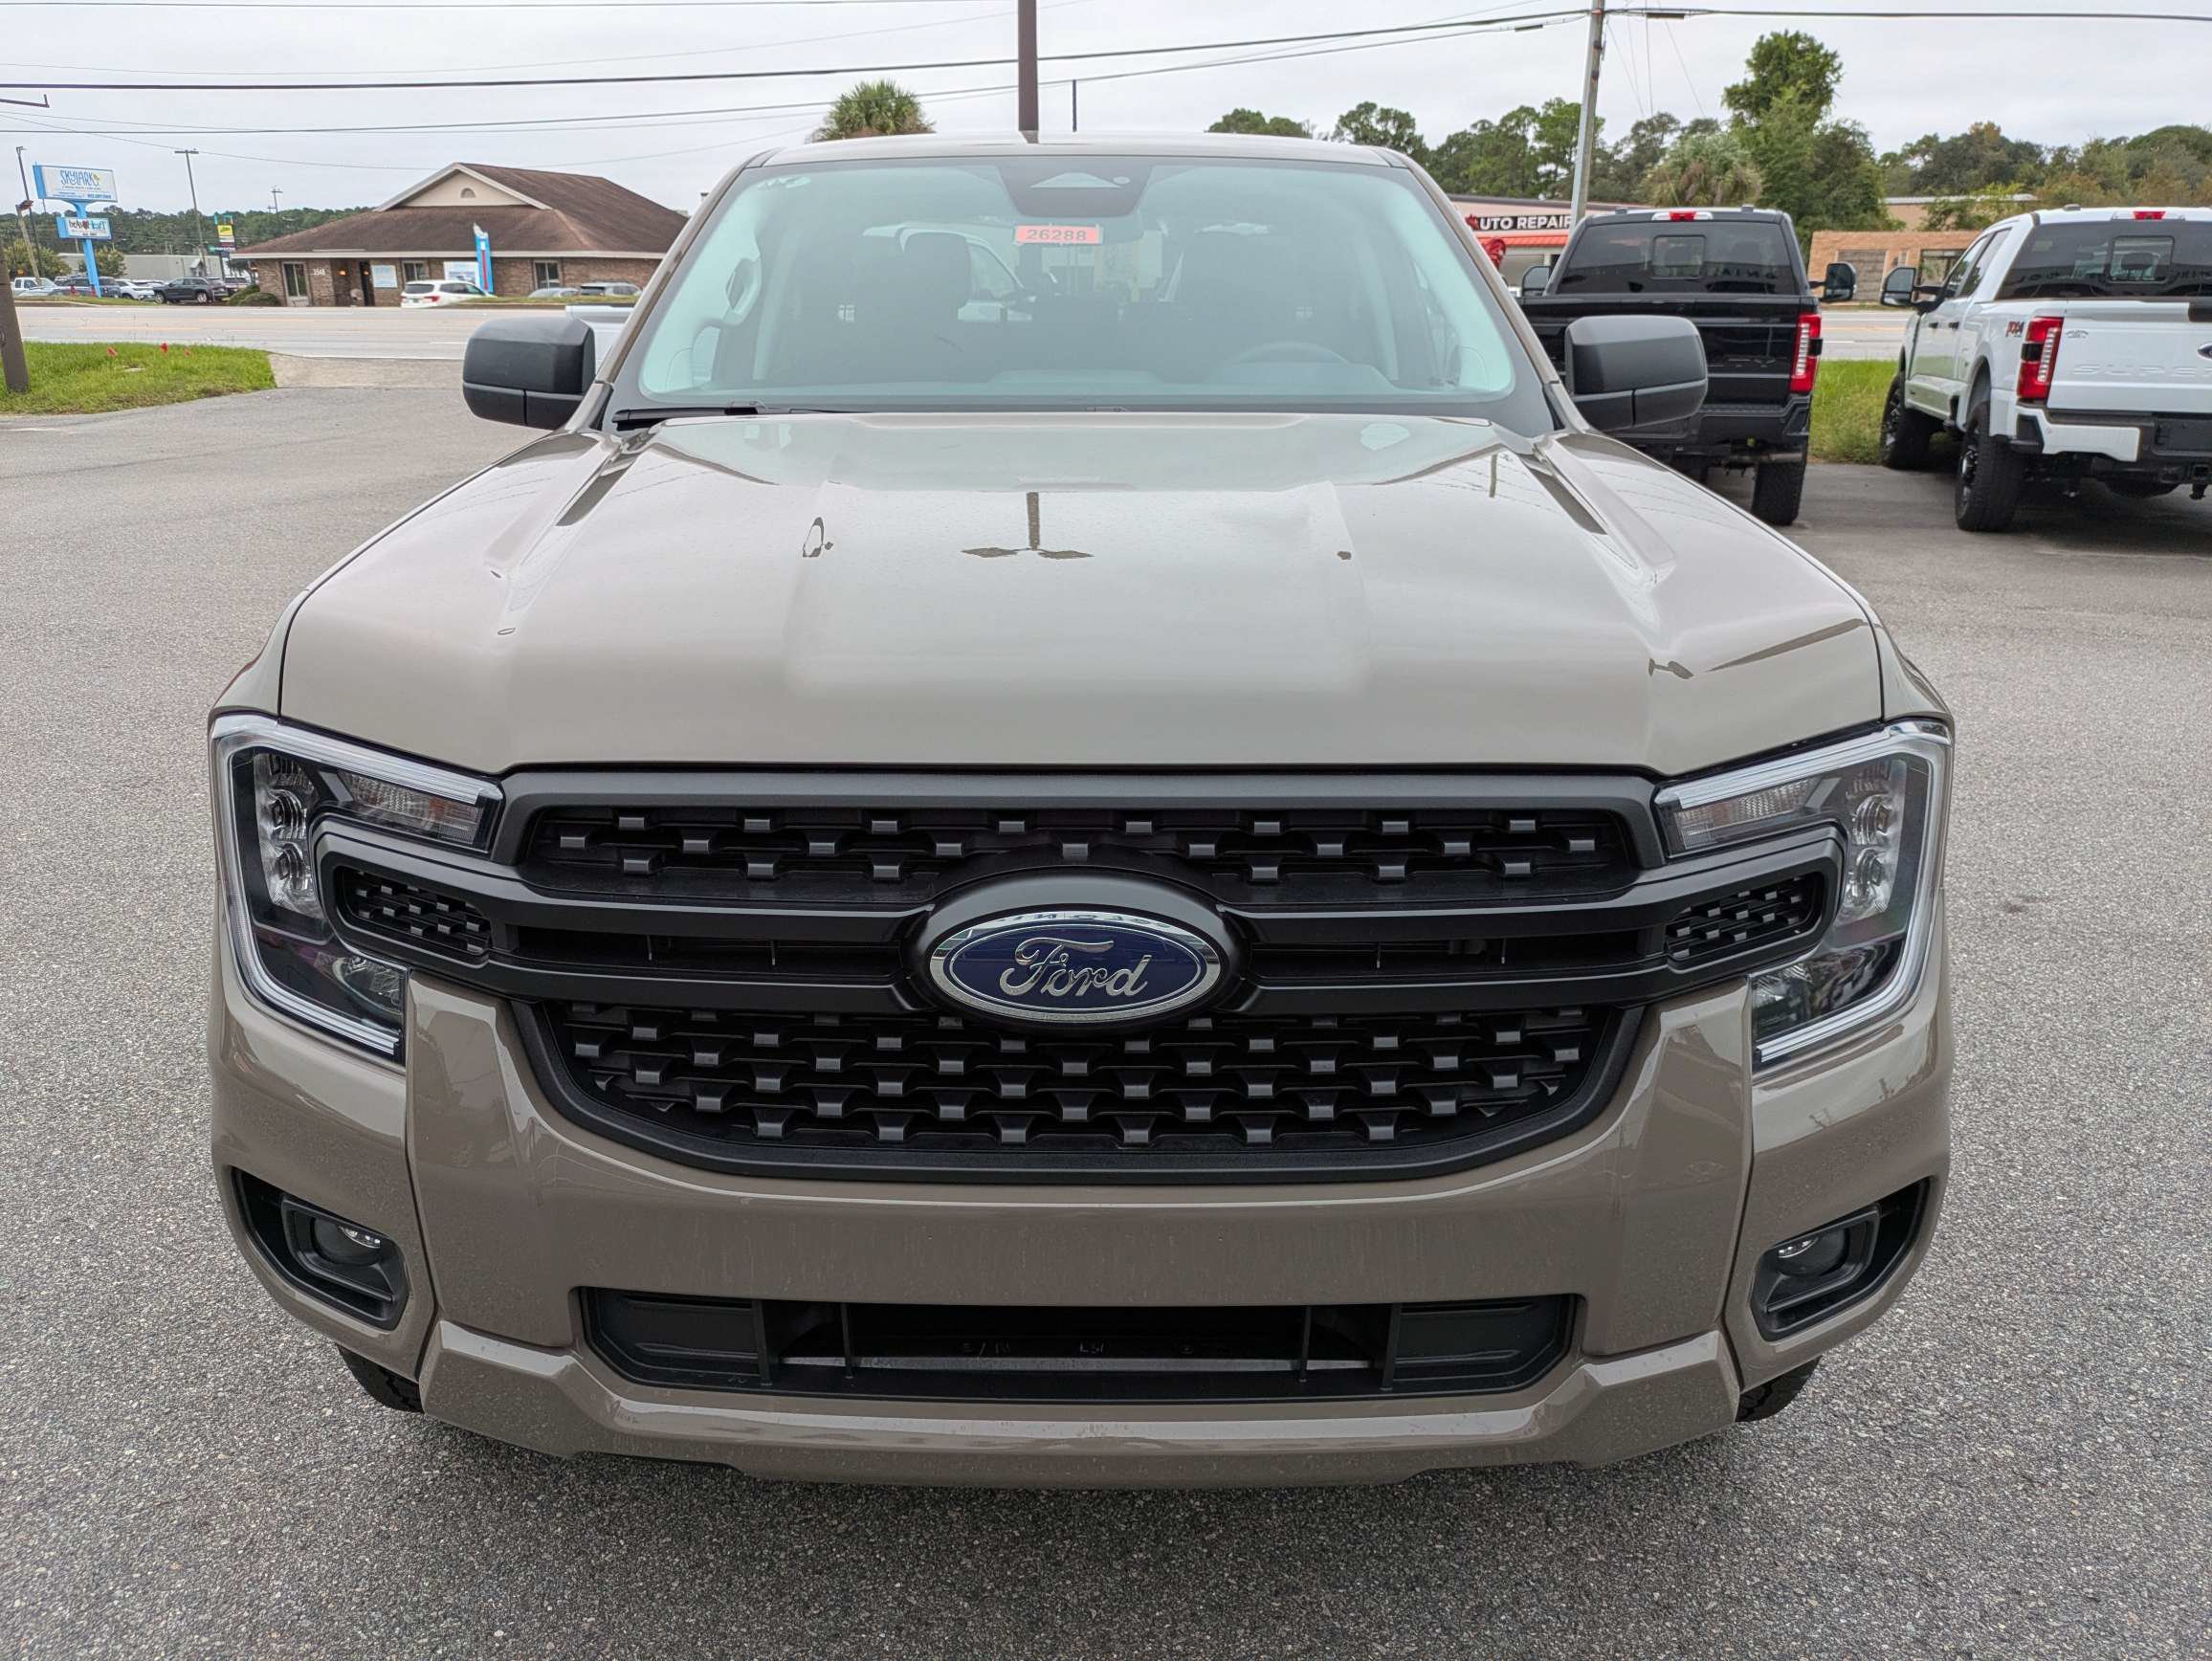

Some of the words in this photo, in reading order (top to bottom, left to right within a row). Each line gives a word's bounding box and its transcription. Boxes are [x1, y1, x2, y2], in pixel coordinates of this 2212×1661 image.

[60, 169, 99, 187] SKYLARK
[1479, 217, 1514, 231] UTO
[1025, 229, 1088, 241] 26288
[999, 937, 1152, 997] Ford
